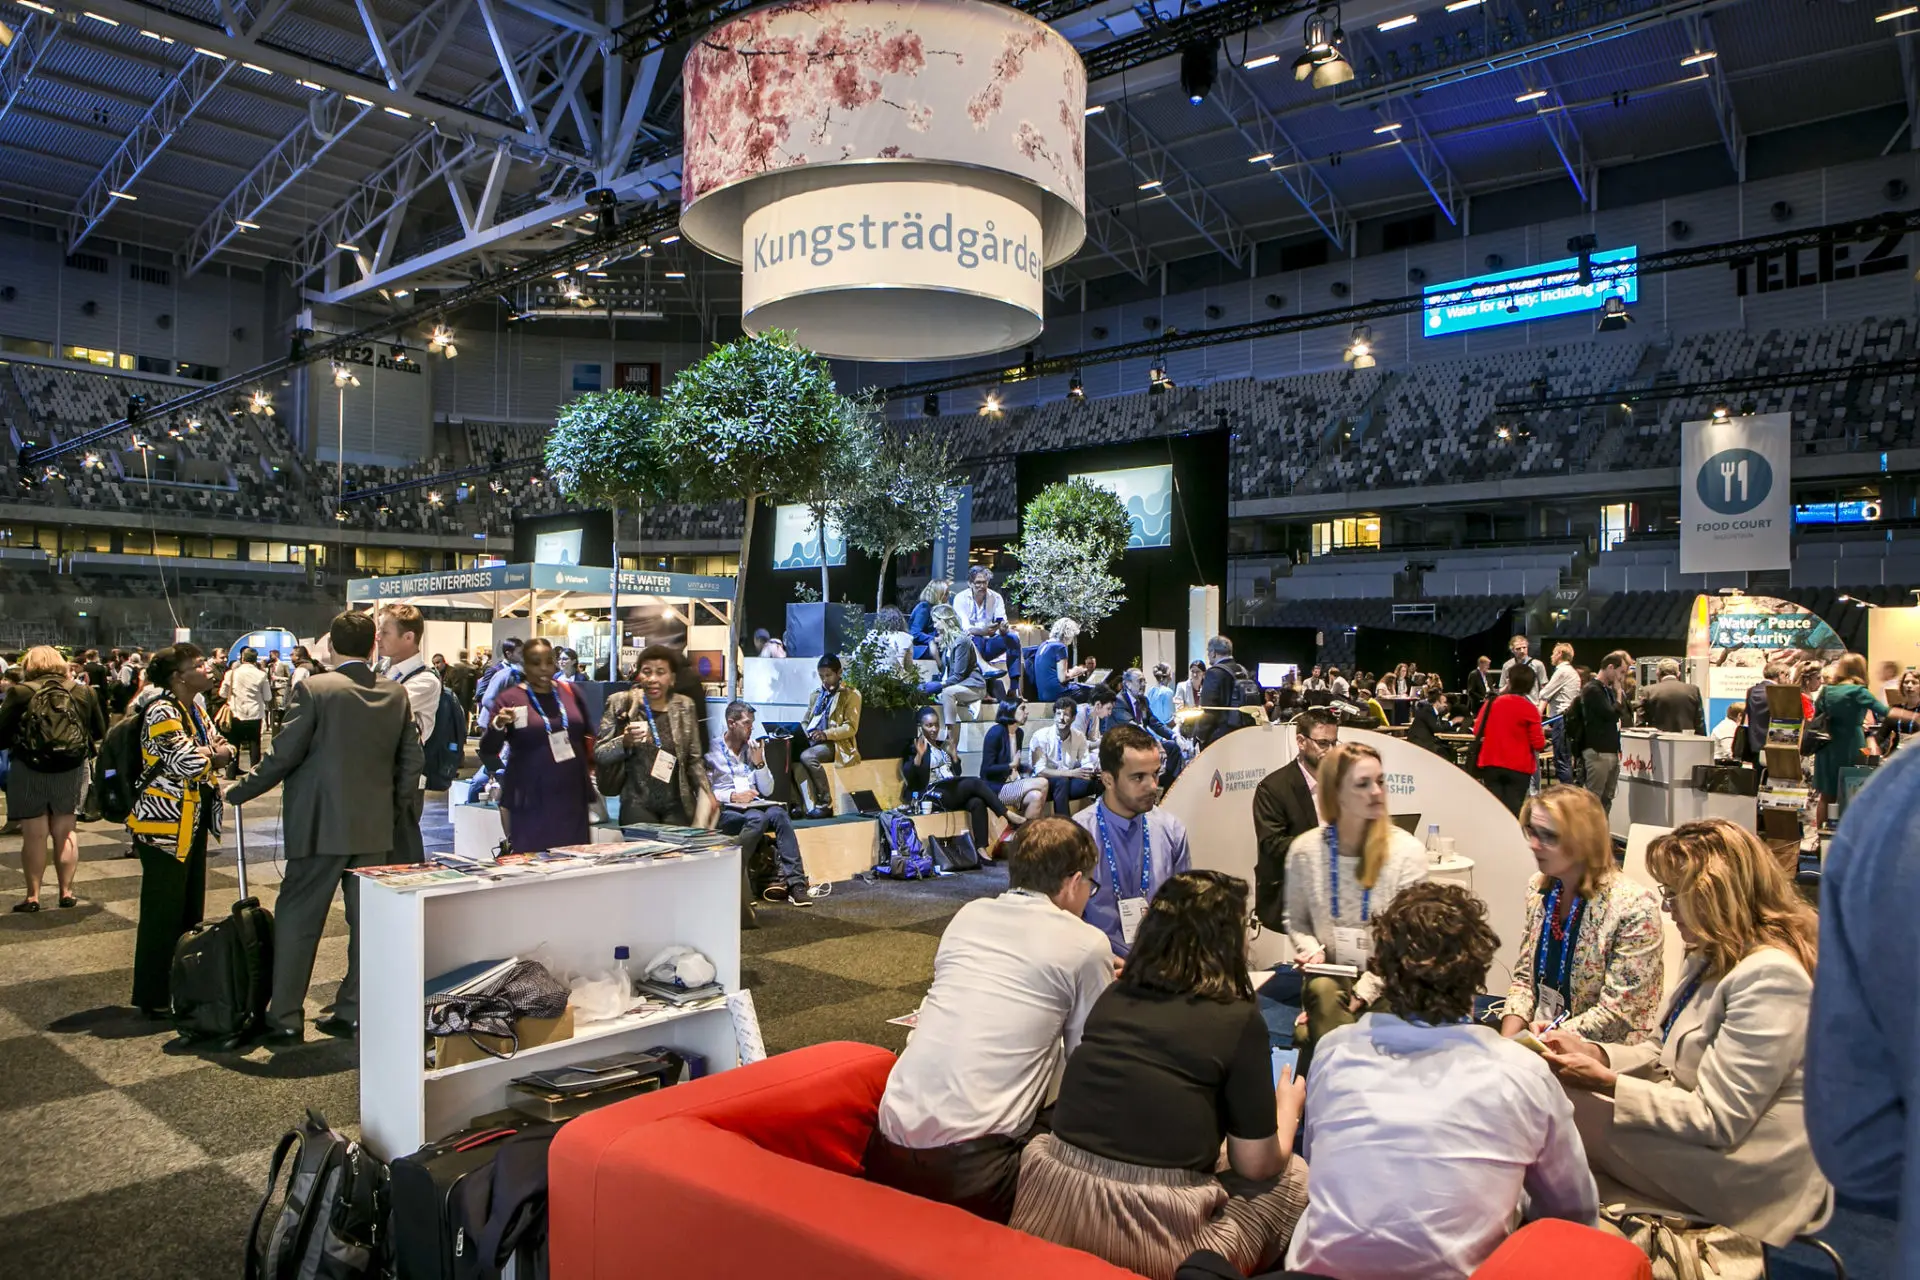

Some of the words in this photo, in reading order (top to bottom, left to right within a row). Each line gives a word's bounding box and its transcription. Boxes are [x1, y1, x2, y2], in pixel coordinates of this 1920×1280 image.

[1446, 304, 1478, 319] Water
[1480, 299, 1495, 313] for
[625, 367, 648, 382] JOB
[1696, 522, 1730, 532] FOOD
[1732, 519, 1772, 530] COURT
[379, 581, 401, 595] SAFE
[402, 578, 429, 593] WATER
[430, 572, 492, 591] ENTERPRISES
[637, 574, 671, 586] WATER
[1555, 591, 1578, 600] A127
[1718, 617, 1765, 631] Water,
[1768, 617, 1811, 629] Peace
[1719, 632, 1730, 644] &
[1733, 631, 1793, 646] Security
[1225, 771, 1244, 781] SWISS
[1245, 768, 1266, 779] WATER
[1225, 780, 1258, 792] PARTNERS
